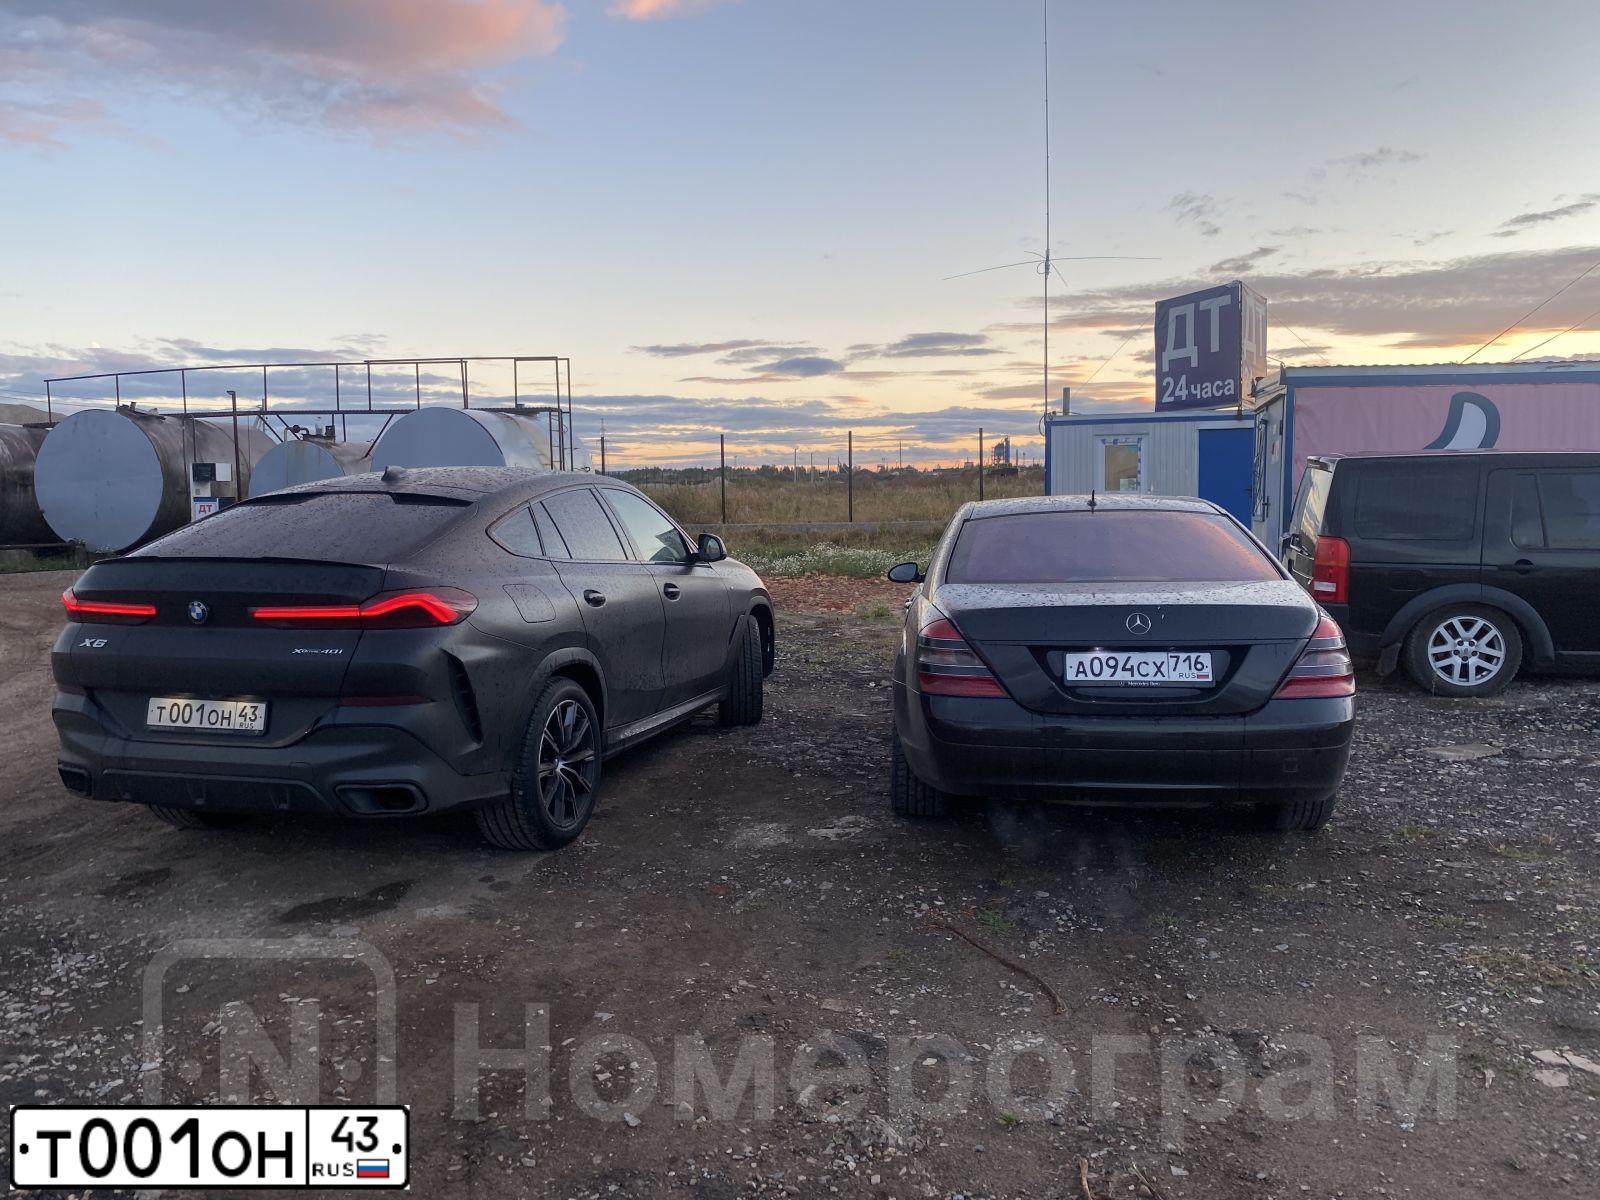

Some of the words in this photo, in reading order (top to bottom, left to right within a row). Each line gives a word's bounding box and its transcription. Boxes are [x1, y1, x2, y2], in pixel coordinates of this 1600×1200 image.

[1162, 294, 1231, 372] ДТ
[1162, 374, 1188, 403] 24
[1190, 378, 1235, 398] часа
[199, 504, 212, 514] ДТ
[79, 638, 107, 648] X6
[1074, 656, 1166, 678] А094СХ
[1169, 655, 1205, 672] 716
[156, 703, 232, 727] Т001ОН
[238, 705, 259, 722] 43
[239, 721, 254, 729] RUS
